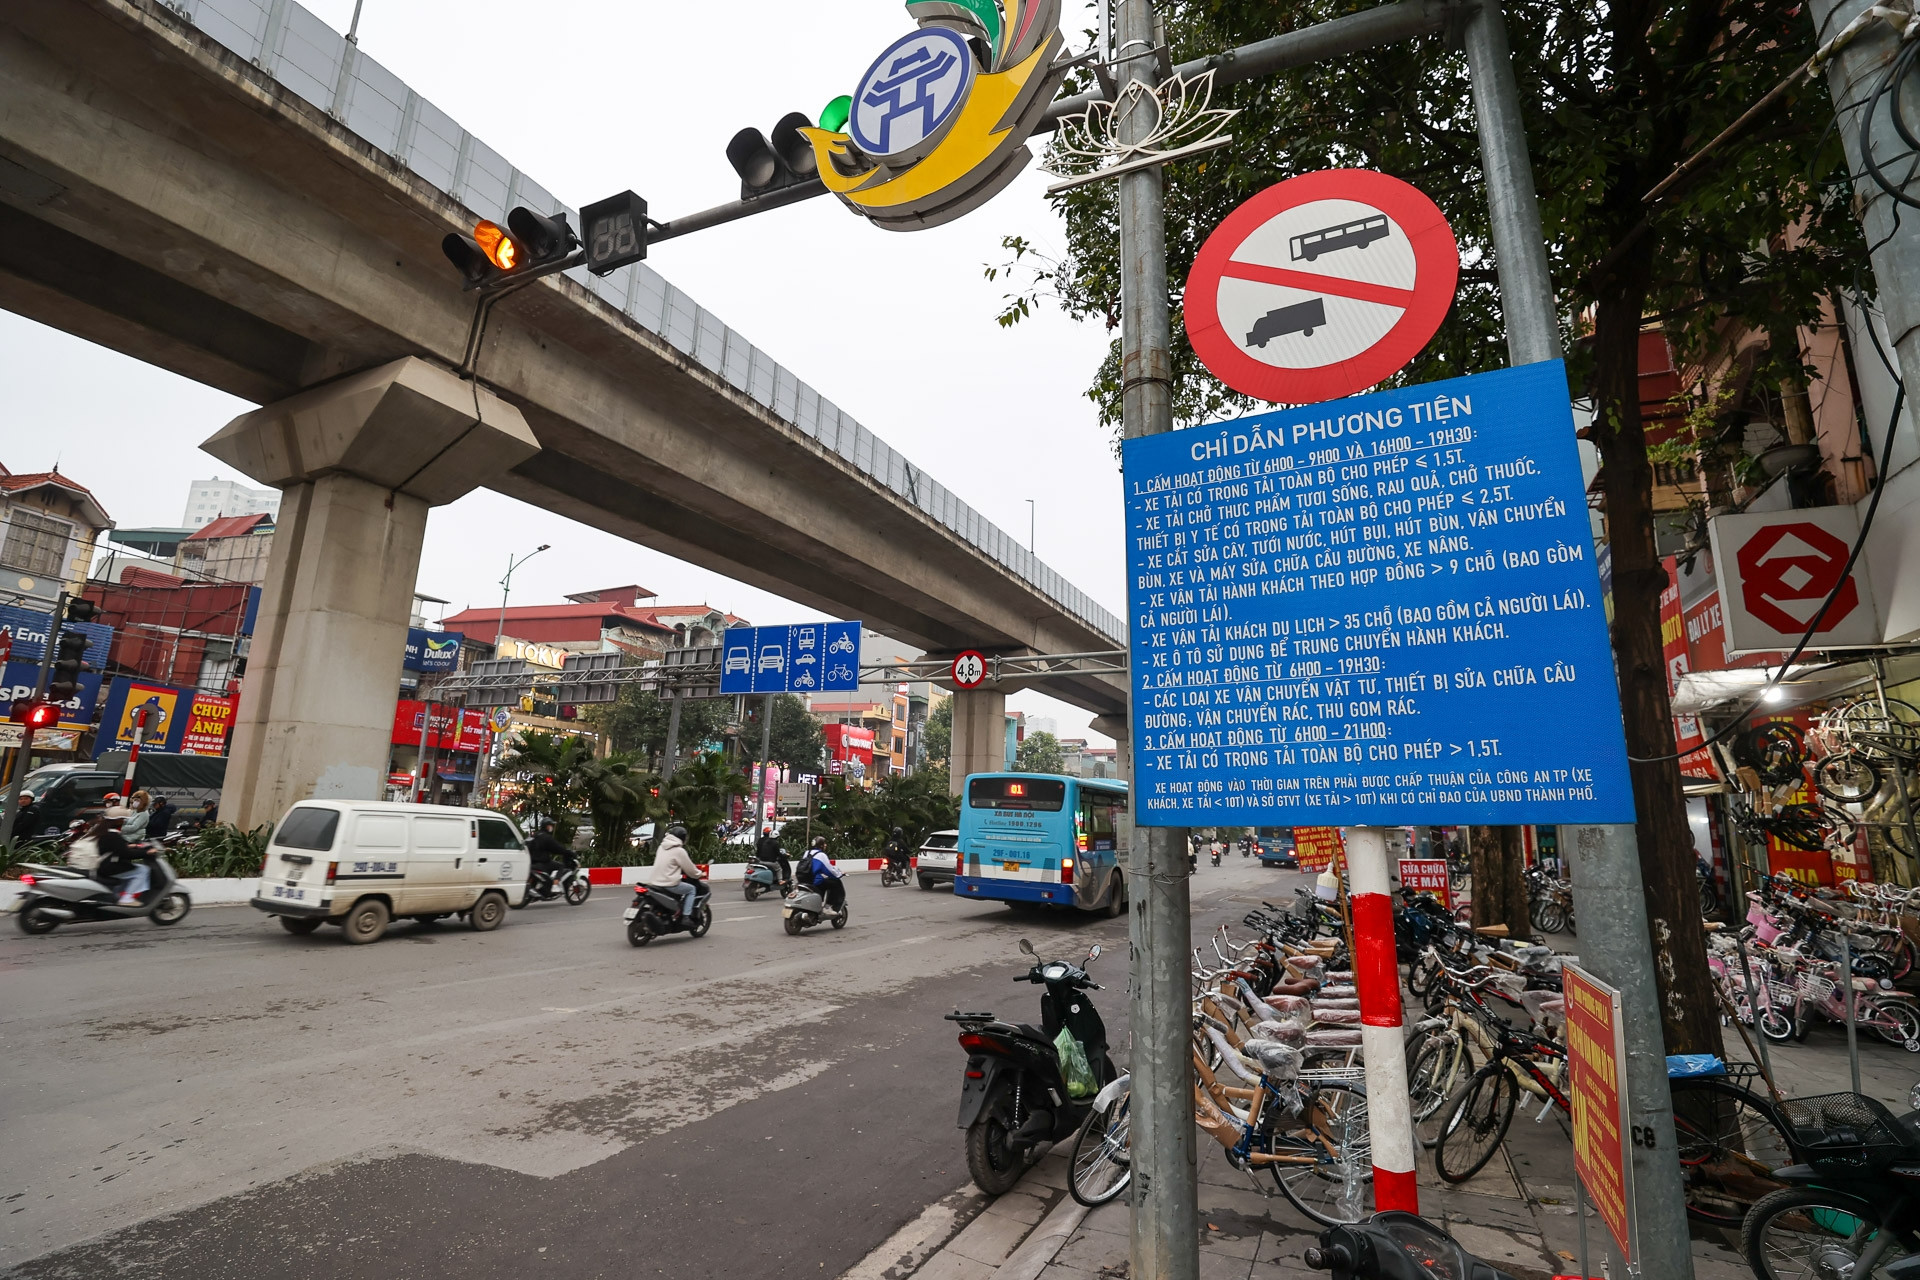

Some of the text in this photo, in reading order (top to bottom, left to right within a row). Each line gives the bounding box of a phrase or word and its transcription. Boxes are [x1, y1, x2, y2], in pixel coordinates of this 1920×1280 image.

[1191, 394, 1472, 461] CHỈ DẪN PHƯƠNG TIỆN
[1146, 473, 1173, 492] CẤM
[1174, 470, 1206, 488] HOẠT
[1207, 464, 1240, 483] ĐỘNG
[1243, 458, 1260, 476] TỪ
[1263, 455, 1294, 474] 6H00
[1308, 447, 1342, 466] 9H00
[1346, 440, 1366, 460] VÀ
[1371, 435, 1411, 456] 16H00
[1144, 498, 1159, 512] XE
[1165, 488, 1184, 508] TẢI
[1186, 486, 1202, 505] CÓ
[1208, 485, 1249, 503] TRỌNG
[1253, 475, 1274, 494] TẢI
[1278, 471, 1312, 490] TOÀN
[1317, 466, 1335, 486] BỘ
[1341, 463, 1368, 481] CHO
[1373, 454, 1410, 476] PHÉP
[1145, 515, 1160, 530] XE
[1165, 509, 1183, 527] TẢI
[1188, 504, 1211, 524] CHỞ
[1255, 492, 1290, 514] PHẨM
[1295, 490, 1326, 508] TƯƠI
[1331, 482, 1373, 503] SỐNG,
[1376, 478, 1404, 496] RAU
[1410, 469, 1445, 491] QUẢ,
[1448, 463, 1478, 486] CHỞ
[1484, 455, 1540, 480] THUỐC,
[1148, 499, 1565, 569] XE CẮT SỬA CÂY, TƯỚI NƯỚC, HÚT BỤI, HÚT BÙN, VẬN CHUYỂN
[1140, 603, 1232, 628] CẢ NGƯỜI LÁI).
[1709, 603, 1722, 630] XE
[424, 648, 453, 659] Dulux
[957, 661, 981, 678] 4,8m
[1157, 668, 1182, 688] CẤM
[1187, 668, 1218, 687] HOẠT
[1223, 664, 1260, 683] ĐỘNG
[1264, 660, 1282, 679] TỪ
[1289, 660, 1321, 677] 6H00
[192, 703, 231, 720] CHỤP
[1159, 729, 1186, 750] CẤM
[1190, 730, 1222, 750] HOẠT
[1227, 727, 1263, 748] ĐỘNG
[1268, 723, 1288, 743] TỪ
[1294, 724, 1328, 742] 6H00
[1010, 784, 1023, 795] 01
[1402, 862, 1445, 874] SỬA CHỮA
[1421, 875, 1445, 888] MÁY
